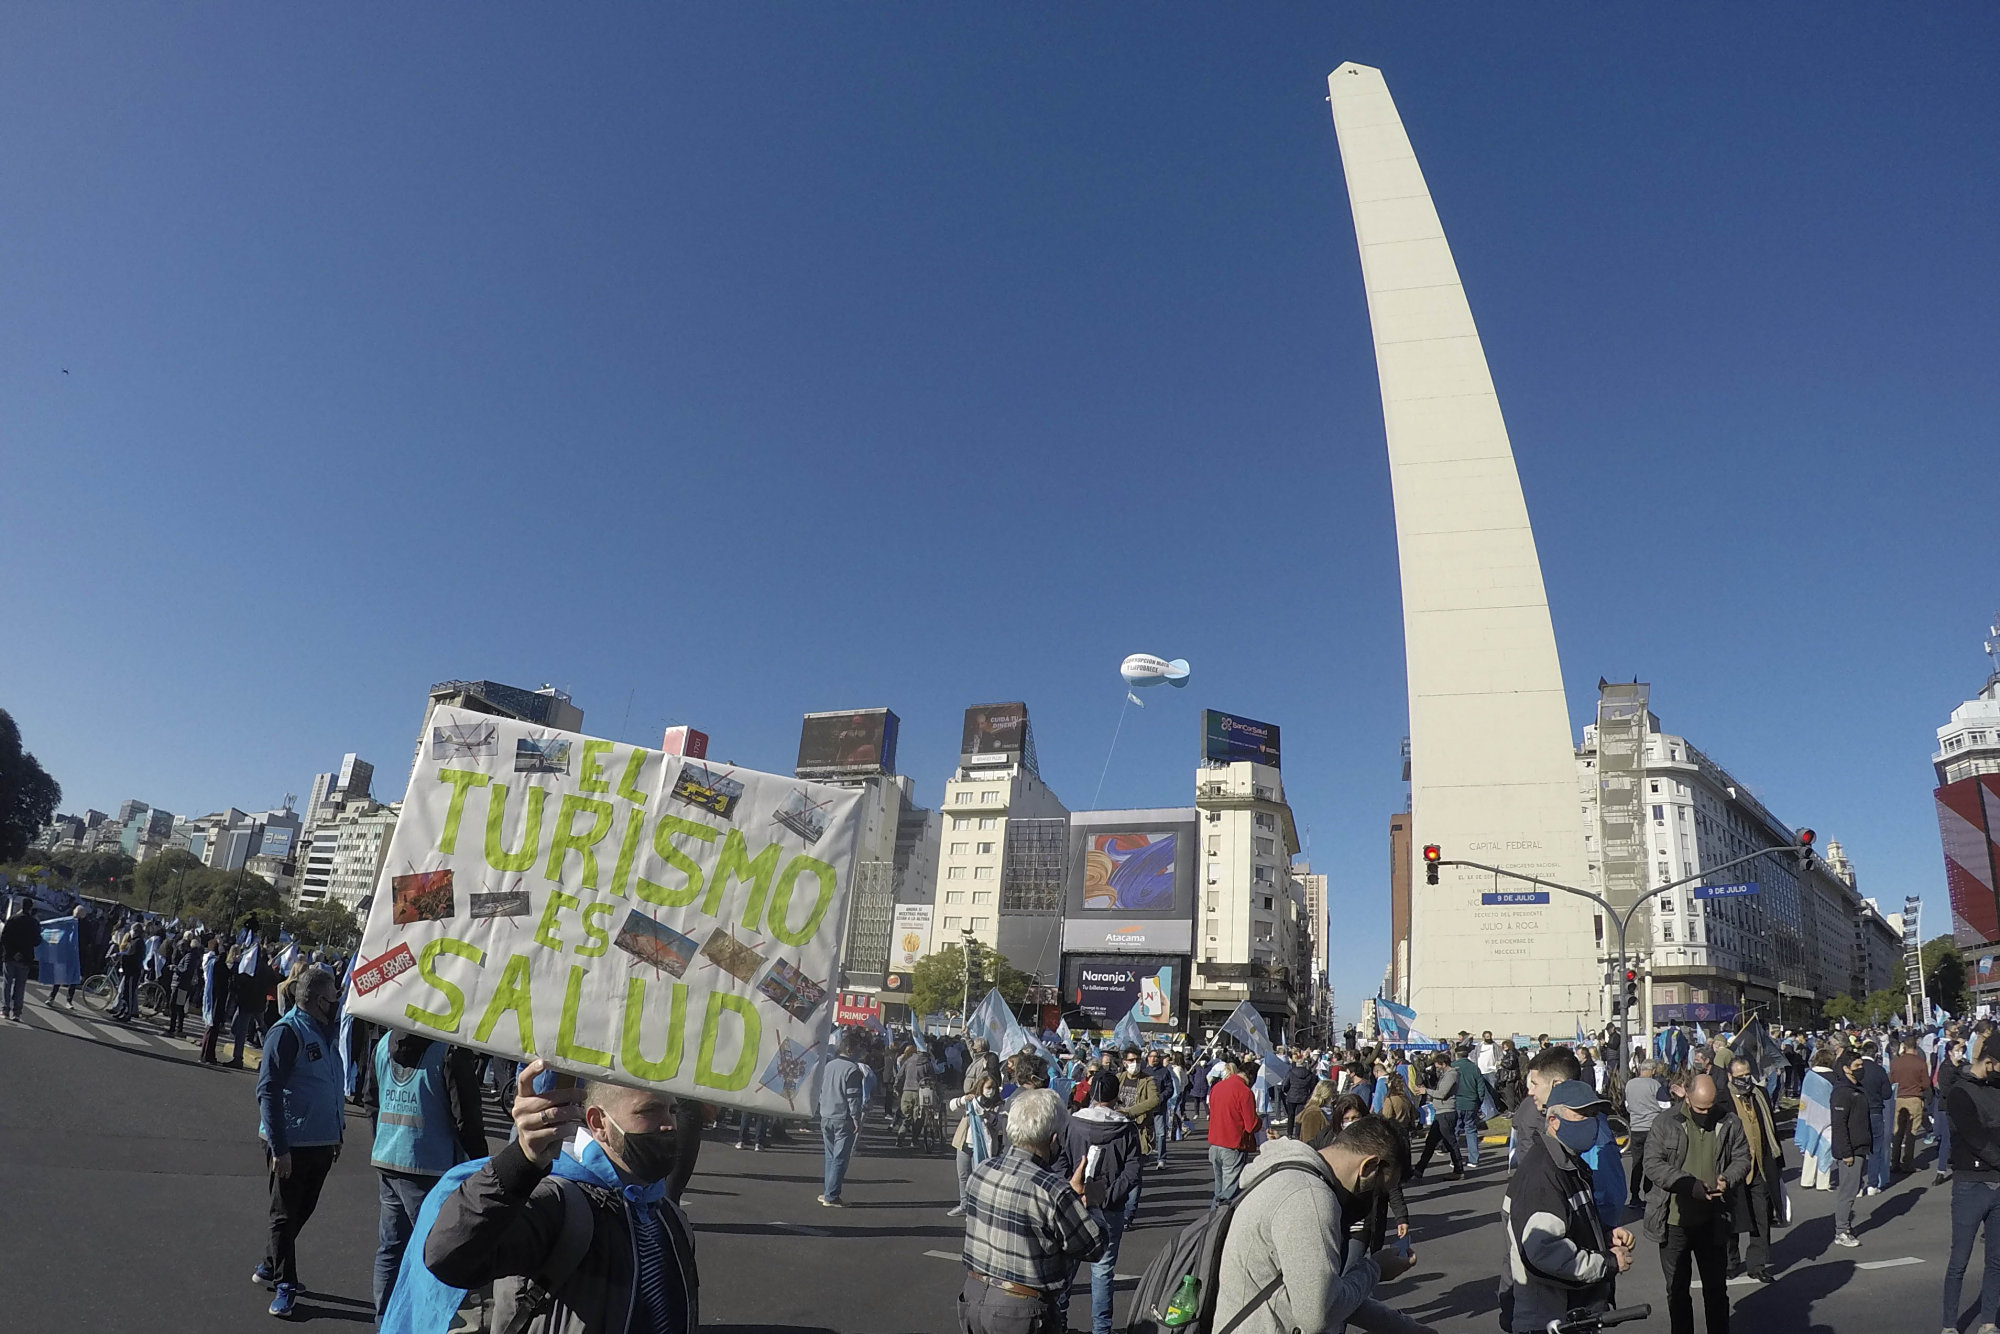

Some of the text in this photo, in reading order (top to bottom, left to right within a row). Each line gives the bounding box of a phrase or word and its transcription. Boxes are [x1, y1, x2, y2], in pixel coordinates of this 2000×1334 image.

[580, 741, 646, 804] EL
[440, 769, 835, 945] TURISMO
[1469, 841, 1542, 850] CAPITAL FEDERAL
[535, 891, 613, 957] ES
[1516, 922, 1539, 930] ROCA
[356, 951, 410, 988] FREE TOURS
[360, 961, 413, 991] TOURS GRATIS
[1082, 971, 1125, 984] Naranja
[406, 938, 760, 1090] SALUD
[840, 1011, 870, 1020] PRIMICI
